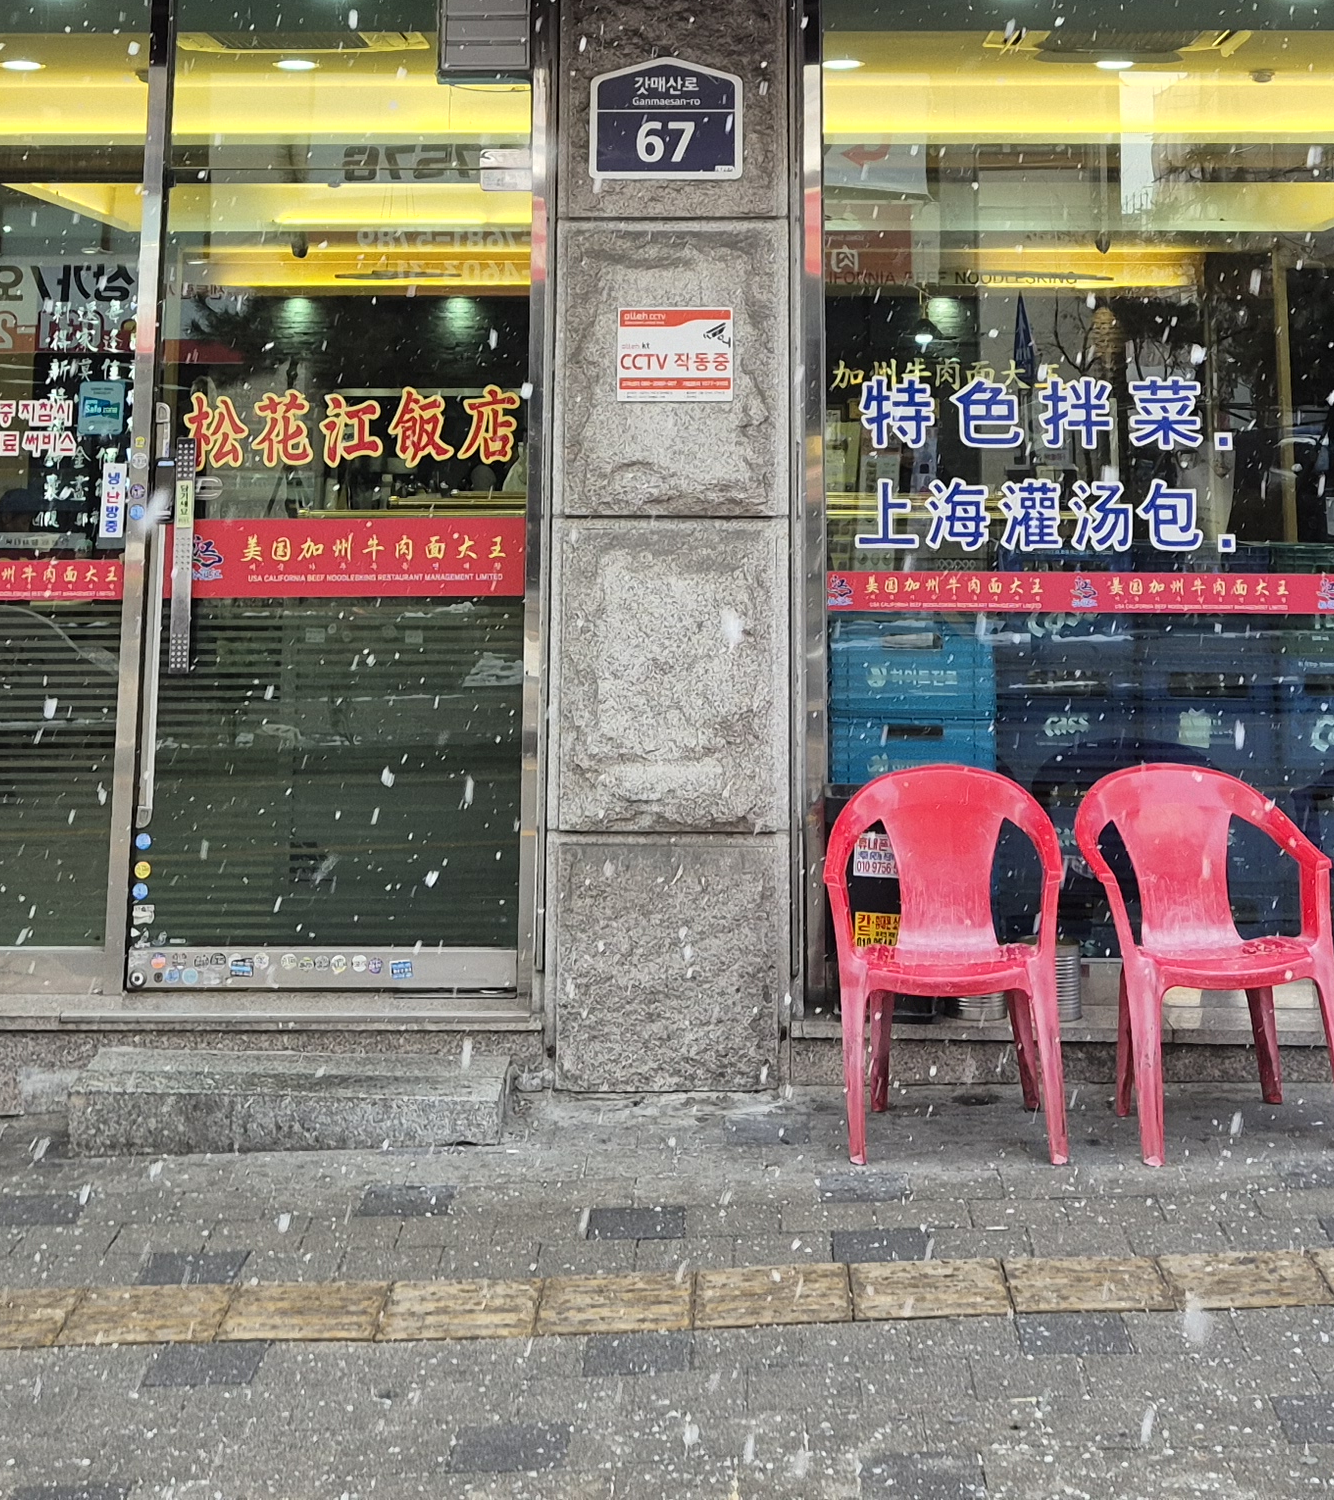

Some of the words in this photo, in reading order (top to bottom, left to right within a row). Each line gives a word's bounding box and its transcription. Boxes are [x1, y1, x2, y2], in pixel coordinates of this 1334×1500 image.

[634, 76, 699, 96] 갓매산로
[632, 96, 701, 106] Ganmaesan-ro
[635, 120, 696, 163] 67
[620, 353, 669, 371] CCTV
[673, 352, 730, 372] 작동중
[18, 400, 74, 428] 지참시
[21, 431, 78, 459] 써비스
[240, 534, 507, 563] 美国加州牛肉面大王
[863, 575, 1044, 595] 美国加州牛肉面大王
[1108, 577, 1290, 597] 美国加州牛肉面大王
